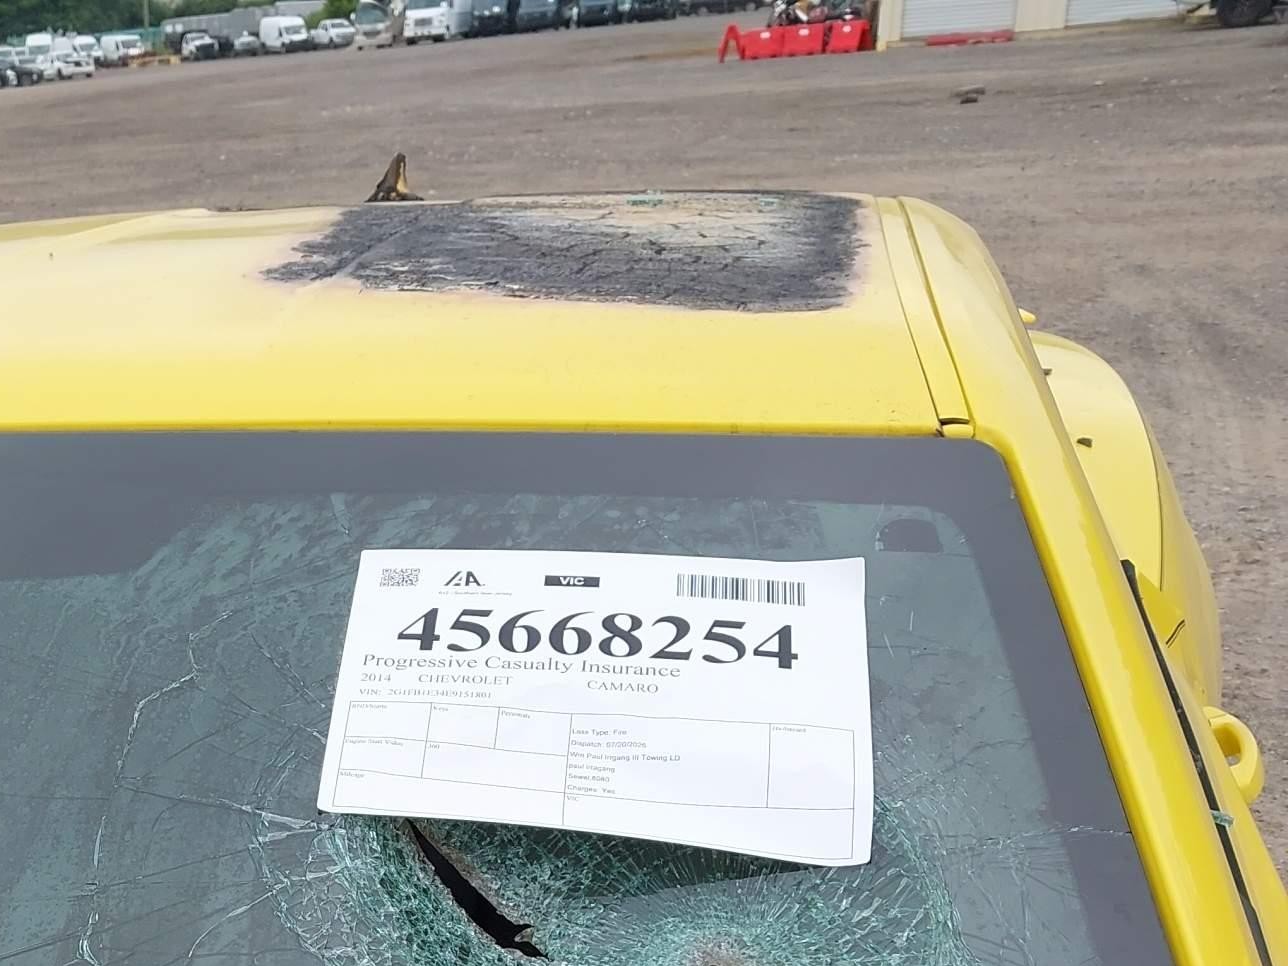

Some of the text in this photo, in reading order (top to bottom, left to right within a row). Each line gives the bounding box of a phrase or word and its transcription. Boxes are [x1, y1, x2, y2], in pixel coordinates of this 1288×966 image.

[559, 576, 585, 586] VIC
[397, 607, 799, 669] 45668254
[362, 653, 681, 678] Progressive Casualty Insurance
[359, 688, 382, 696] VIN:
[360, 672, 660, 695] 2014 CHEVROLET CAMARO
[586, 752, 604, 761] Paul
[641, 753, 668, 763] Towing
